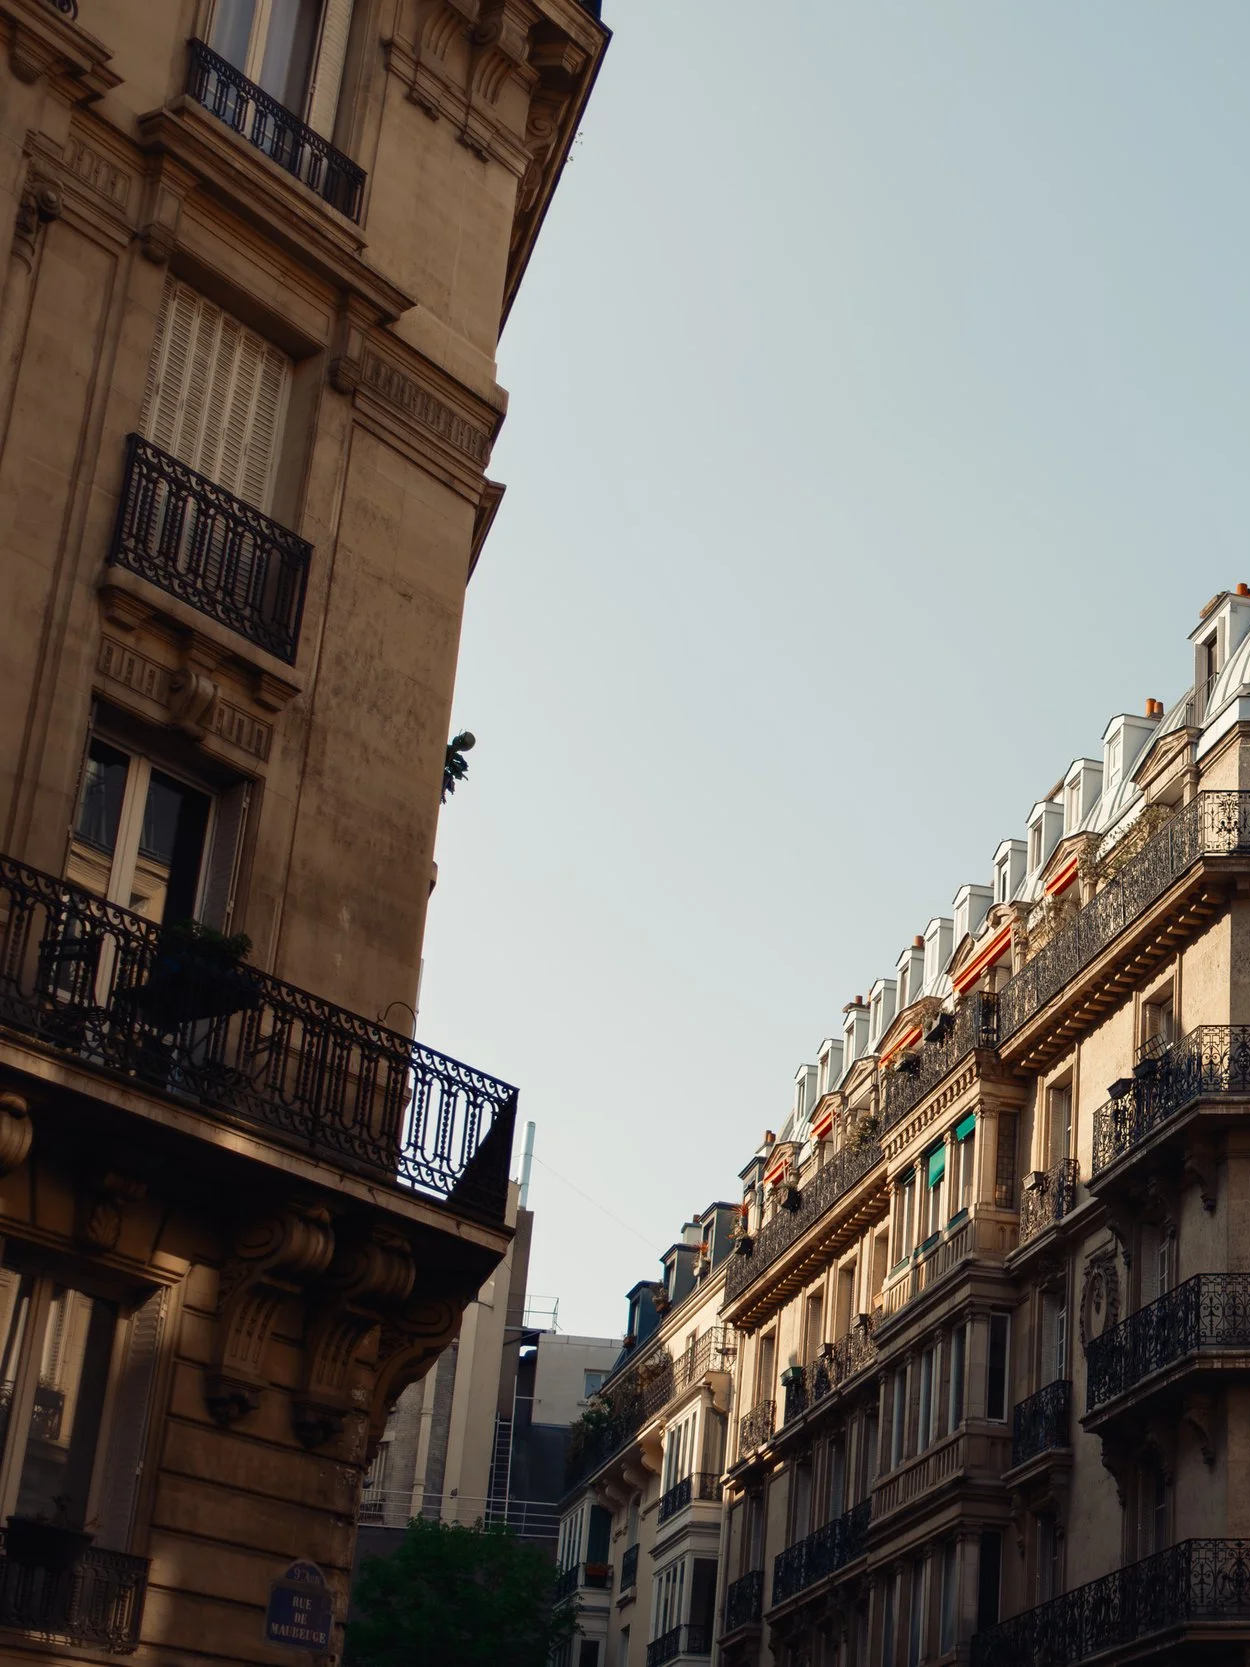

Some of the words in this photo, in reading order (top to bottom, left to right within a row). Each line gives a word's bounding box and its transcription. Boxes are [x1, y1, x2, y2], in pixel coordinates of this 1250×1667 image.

[292, 1595, 312, 1610] RUE
[294, 1612, 308, 1625] DE
[271, 1622, 326, 1644] MAUBEUGE
